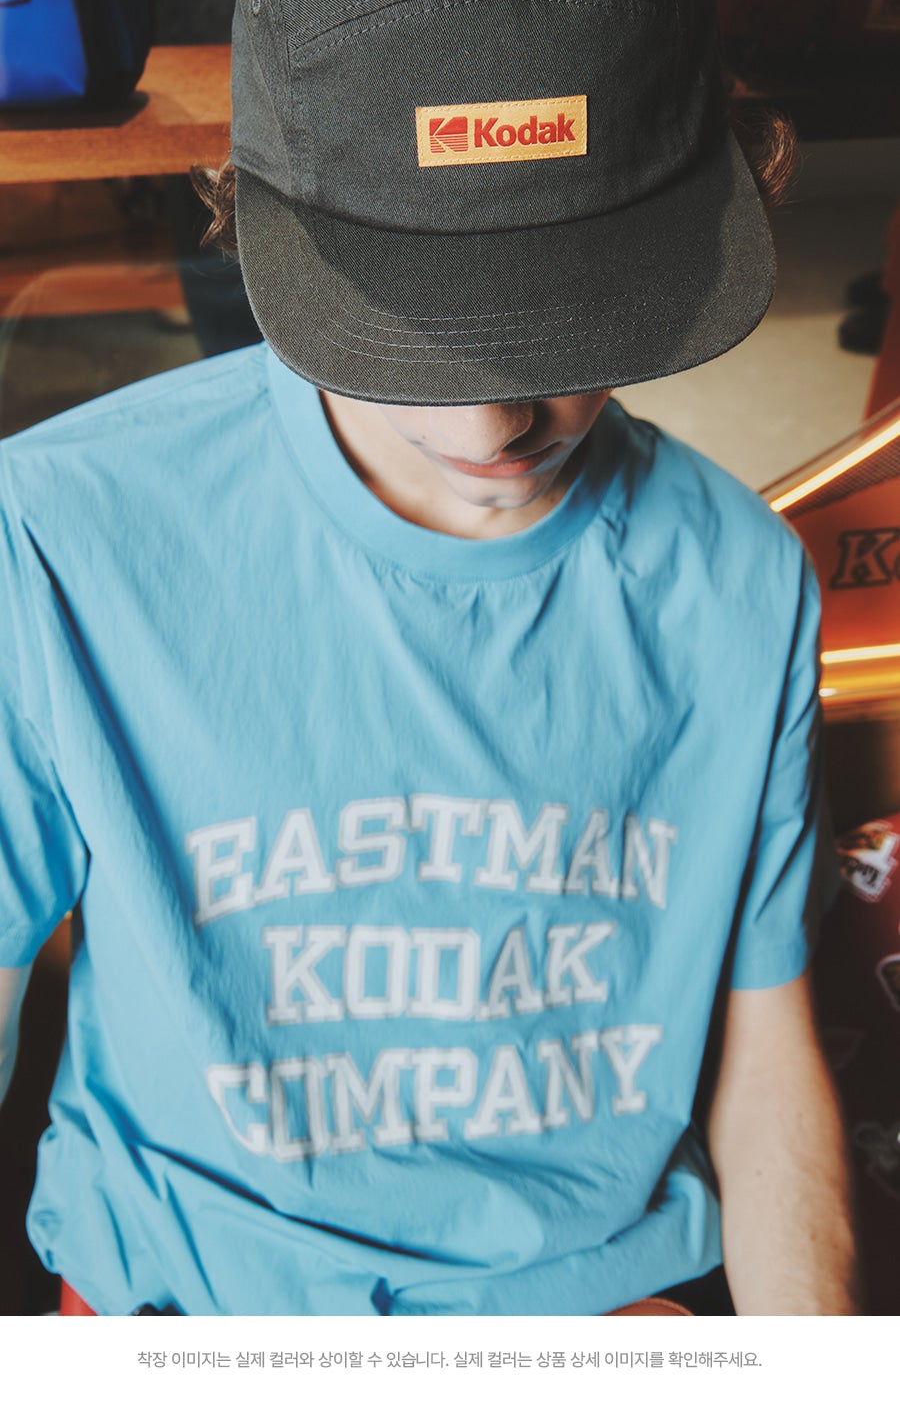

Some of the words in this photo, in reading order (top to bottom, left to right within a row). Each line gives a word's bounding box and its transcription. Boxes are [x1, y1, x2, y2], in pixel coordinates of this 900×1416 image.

[473, 112, 577, 149] Kodak
[185, 793, 678, 932] EASTMAN
[261, 920, 619, 1026] KODAK
[204, 1023, 664, 1163] COMPANY
